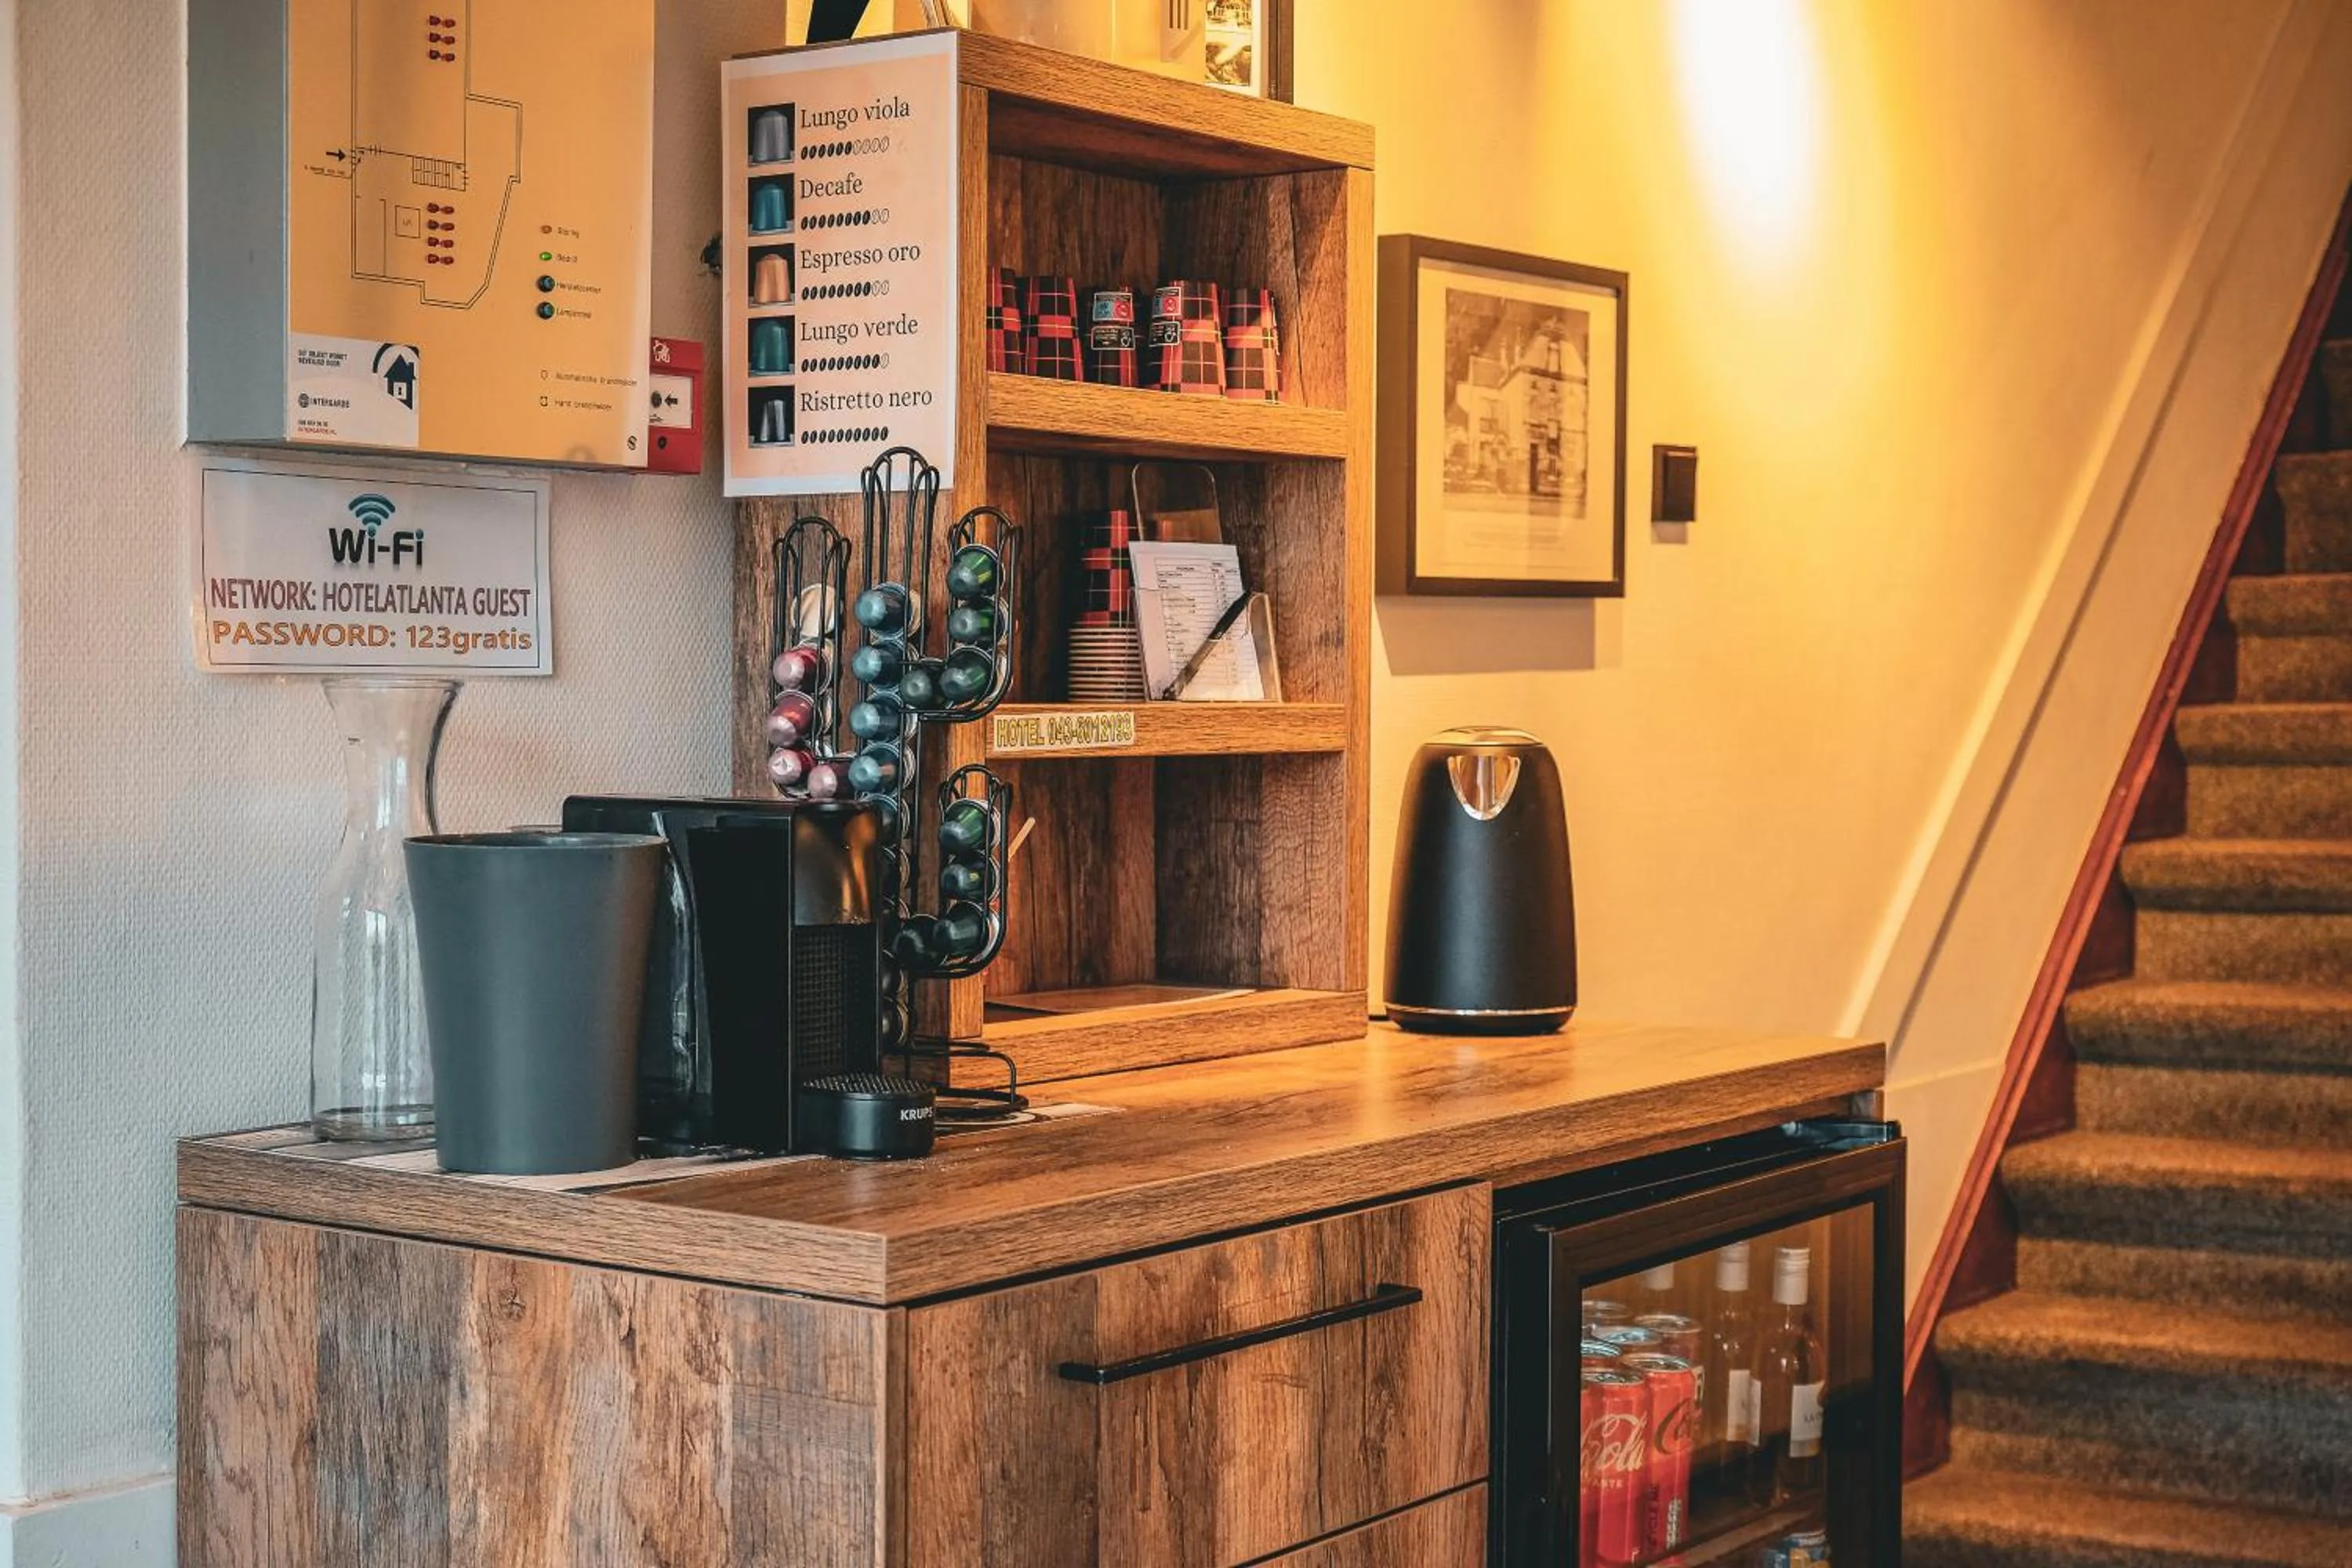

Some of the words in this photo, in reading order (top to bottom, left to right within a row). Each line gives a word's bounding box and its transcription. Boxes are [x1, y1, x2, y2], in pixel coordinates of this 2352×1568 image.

[800, 107, 858, 131] Lungo
[863, 96, 910, 120] viola
[800, 172, 862, 198] Decafe
[800, 248, 883, 273] Espresso
[888, 244, 920, 263] oro
[800, 320, 859, 344] Lungo
[863, 313, 918, 337] verde
[800, 390, 883, 412] Ristretto
[889, 389, 932, 408] nero
[328, 525, 424, 566] Wi-Fi
[210, 578, 317, 611] NETWORK:
[322, 582, 467, 615] HOTELATLANTA
[473, 588, 531, 617] GUEST
[212, 620, 396, 648] PASSWORD:
[406, 625, 532, 654] 123gratis
[996, 717, 1045, 747] HOTEL
